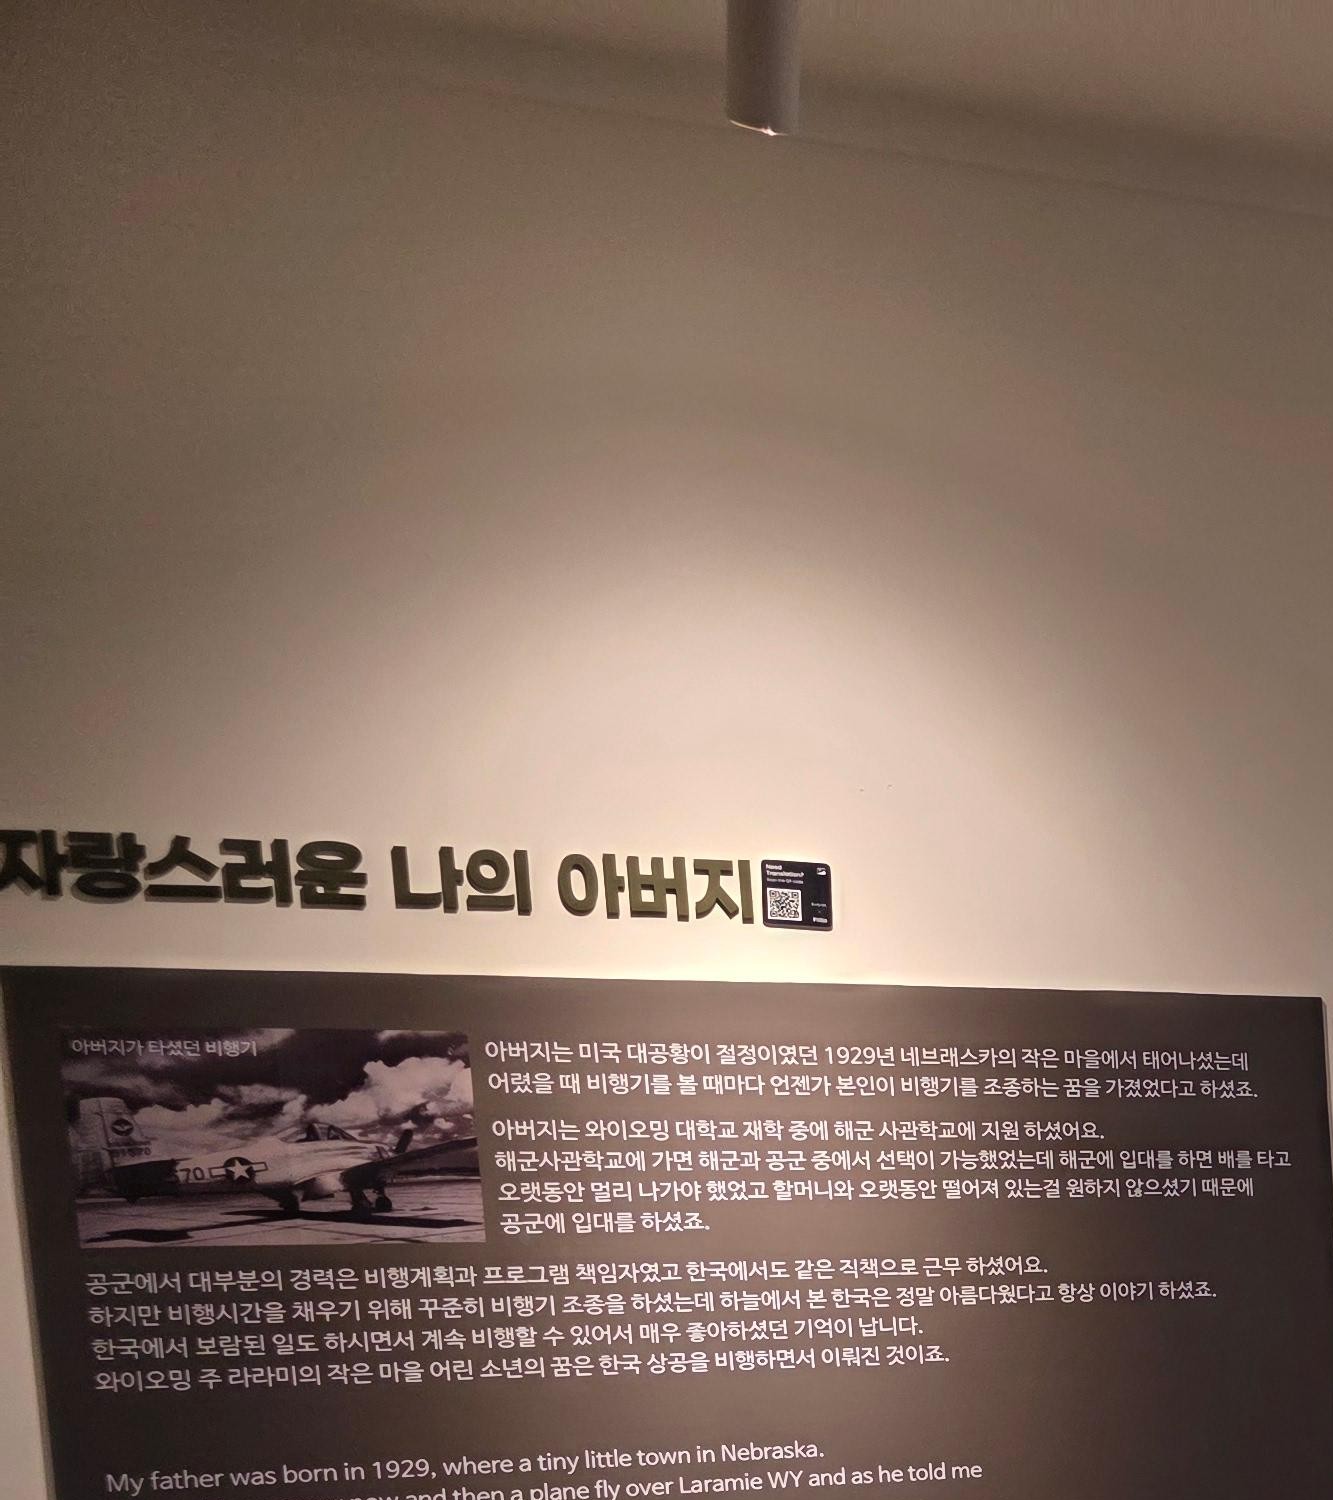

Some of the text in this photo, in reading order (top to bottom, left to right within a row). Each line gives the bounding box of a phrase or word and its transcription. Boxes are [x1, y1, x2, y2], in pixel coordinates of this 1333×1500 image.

[0, 829, 754, 924] 자랑스러운 나의 아버지
[72, 1039, 257, 1057] 아버지가 타셨던 비행기
[484, 1040, 1249, 1071] 아버지는 미국 대공황이 절정이였던 1929년 네브래스카의 작은 마을에서 태어나셨는데
[491, 1119, 1105, 1141] 아버지는 와이오밍 대학교 재학 중에 해군 사관학교에 지원 하셨어요.
[499, 1211, 710, 1235] 공군에 입대를 하셨죠.
[106, 1440, 825, 1497] My father was born in 1929, where a tiny little town in Nebraska.
